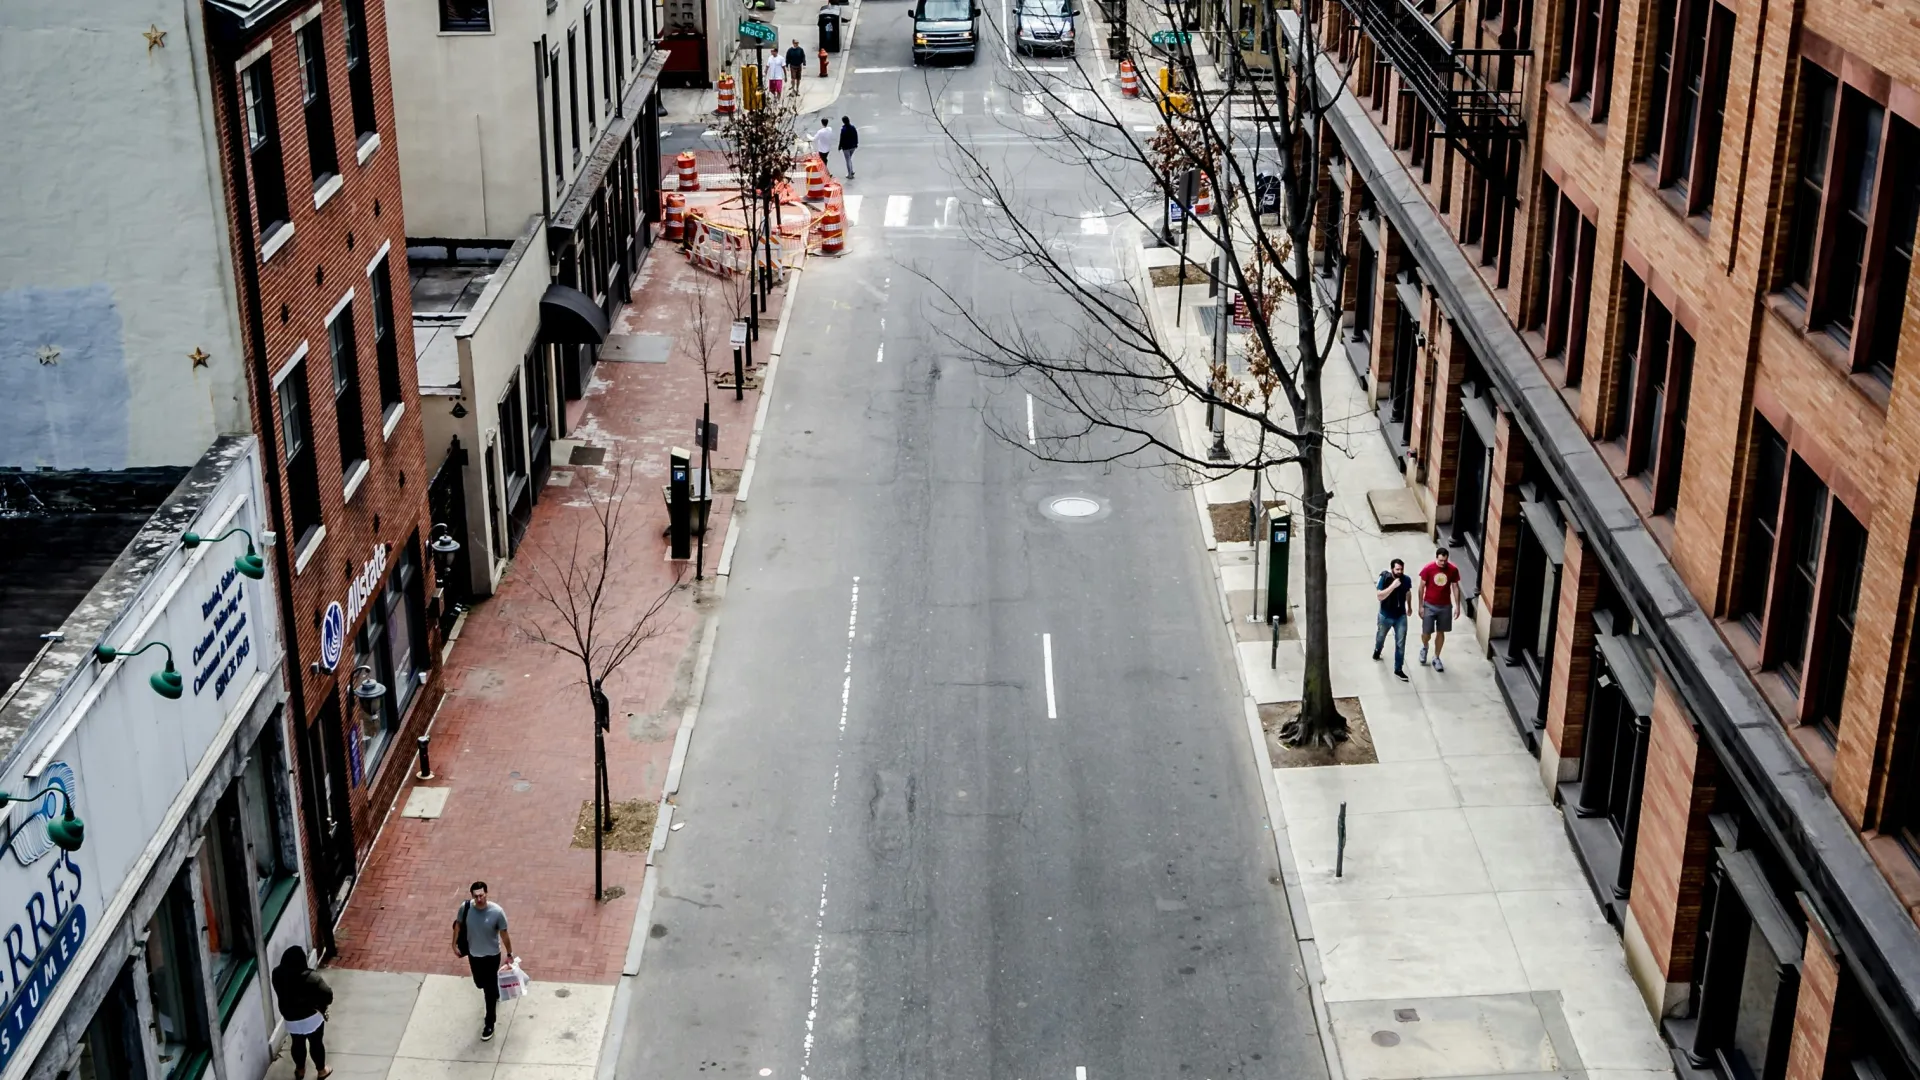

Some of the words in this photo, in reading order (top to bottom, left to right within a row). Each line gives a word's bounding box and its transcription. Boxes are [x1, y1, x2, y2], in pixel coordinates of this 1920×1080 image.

[745, 26, 764, 39] Race
[766, 32, 774, 41] St
[346, 542, 387, 635] Allstate
[193, 629, 215, 667] Custom
[213, 595, 238, 637] Tailoring
[193, 651, 221, 697] Costumes
[215, 655, 237, 702] SINCE
[1, 916, 80, 1055] STUMES
